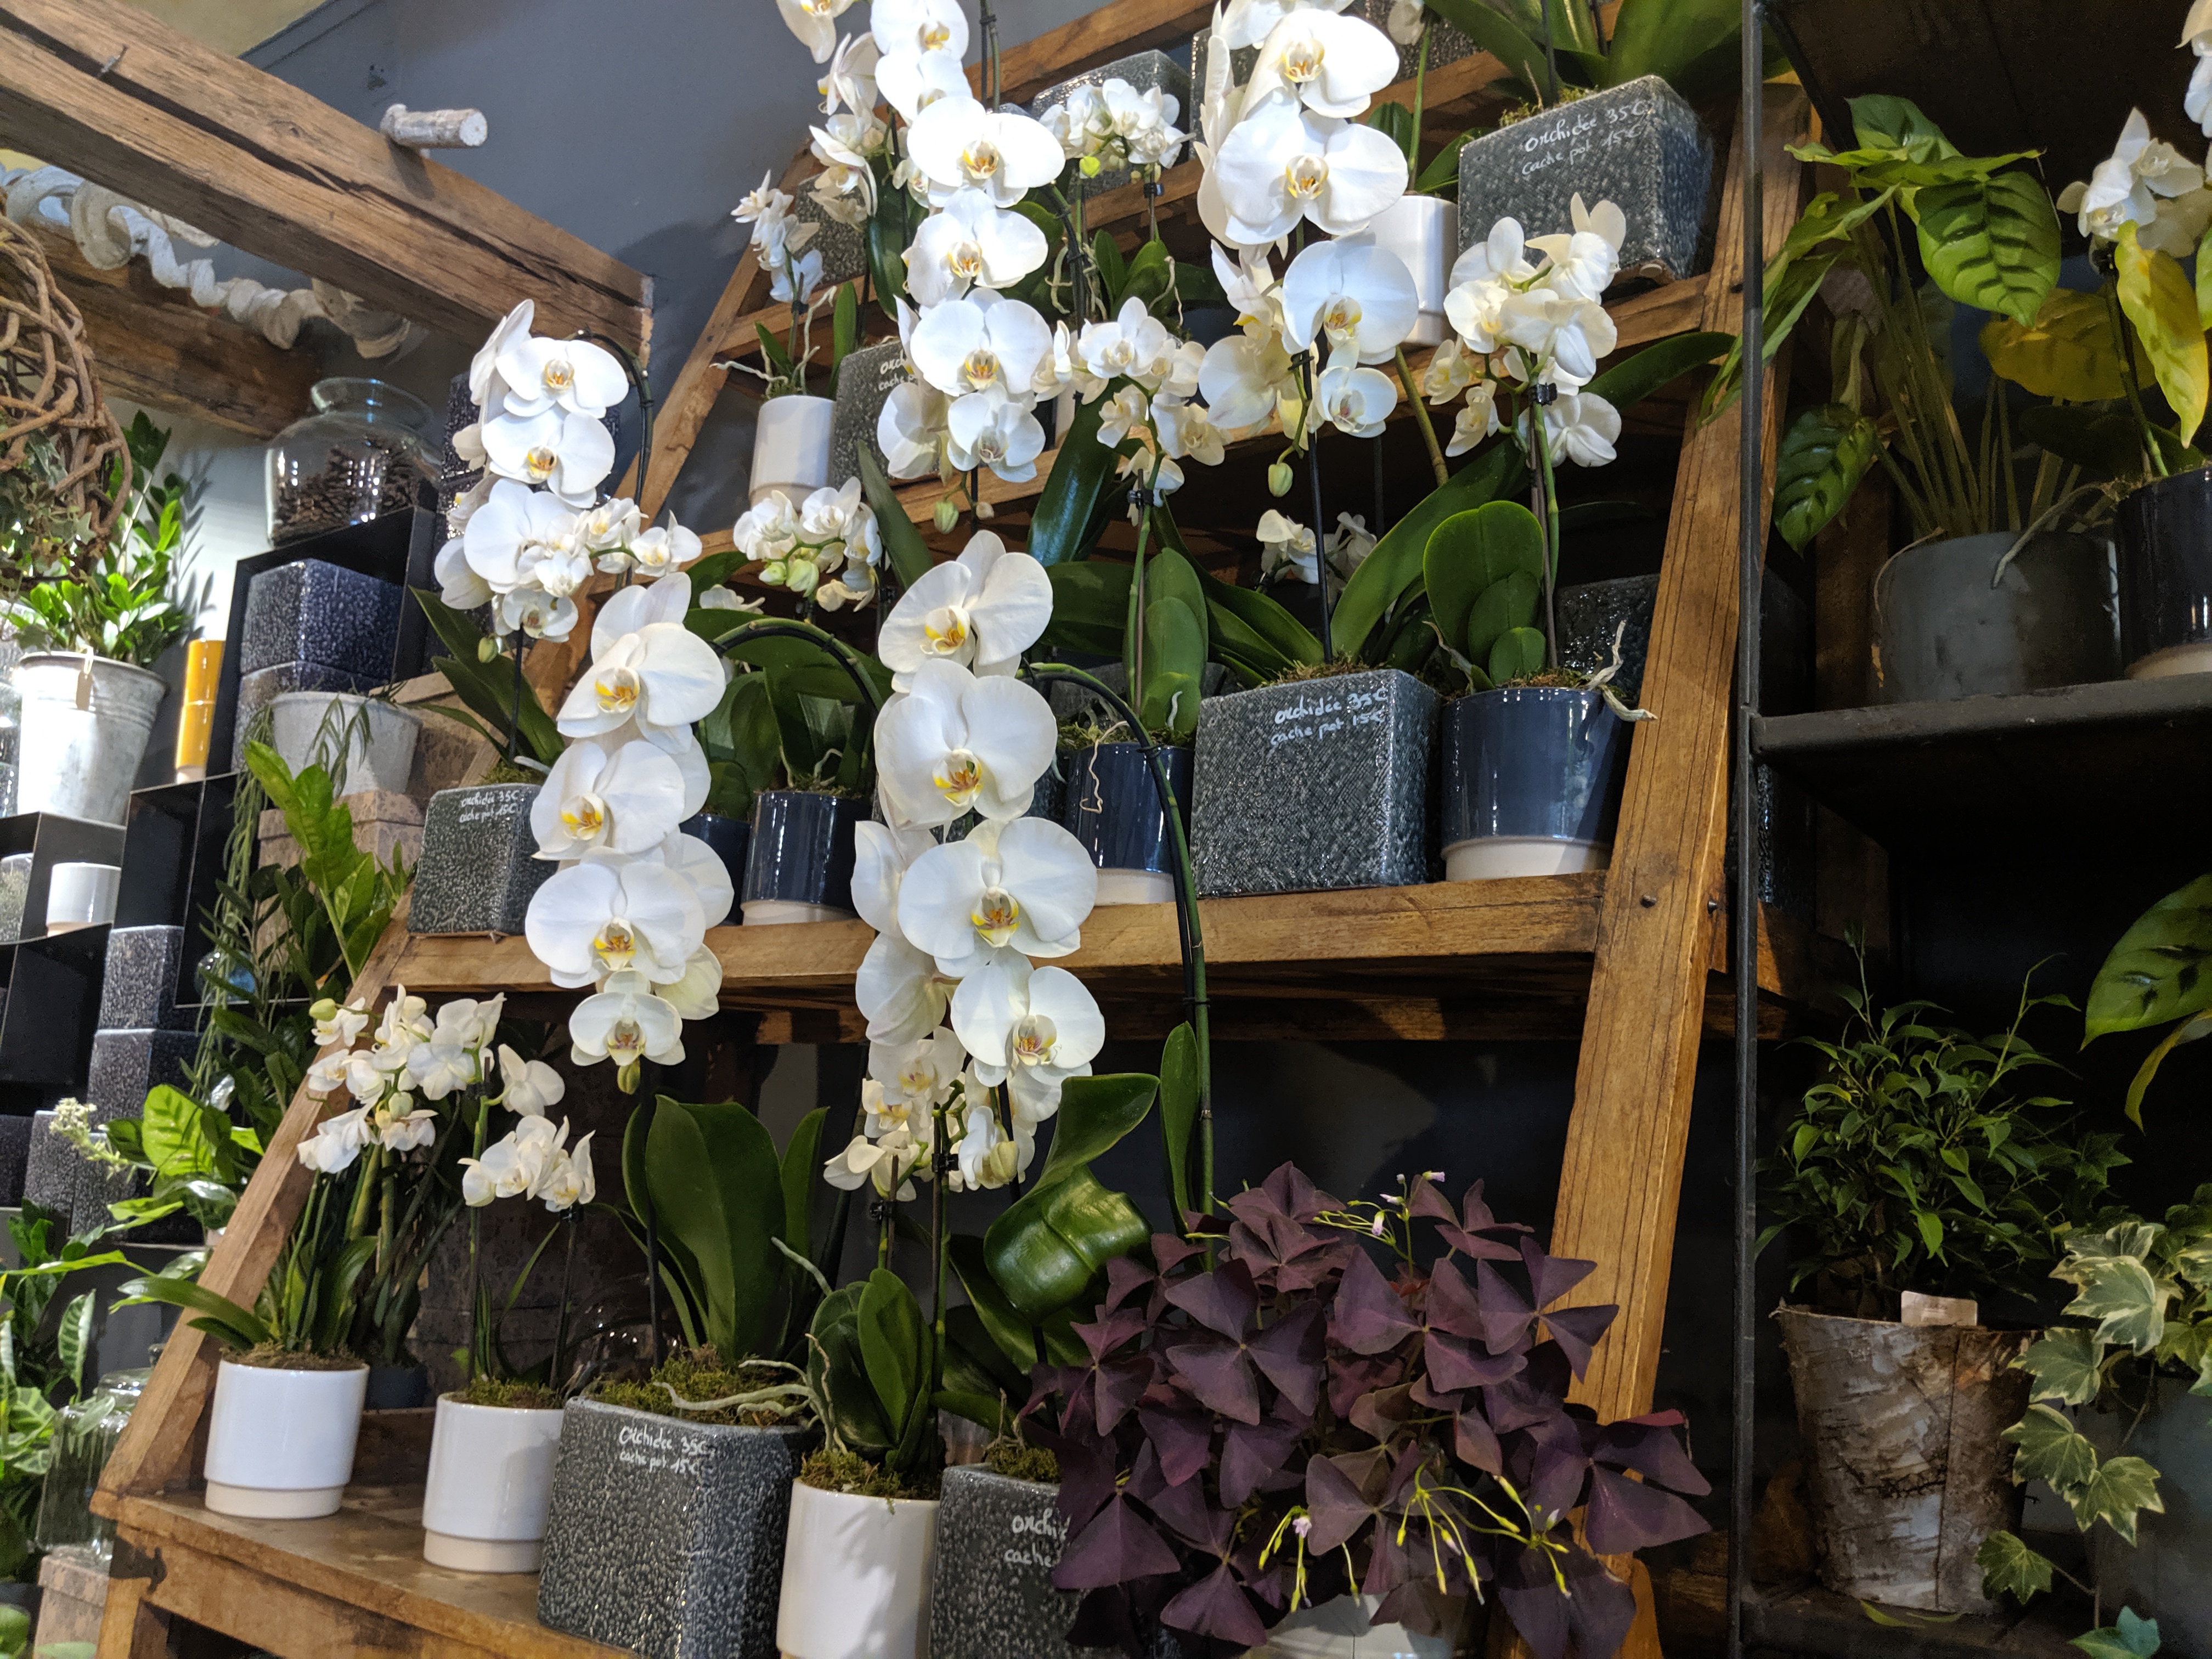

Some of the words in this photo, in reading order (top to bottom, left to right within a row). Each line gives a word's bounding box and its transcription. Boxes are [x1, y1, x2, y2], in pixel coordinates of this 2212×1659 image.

[1521, 150, 1564, 175] cache
[1569, 138, 1593, 165] pot
[1271, 725, 1313, 746] cache
[1318, 717, 1345, 740] pot
[1004, 1542, 1052, 1568] cache
